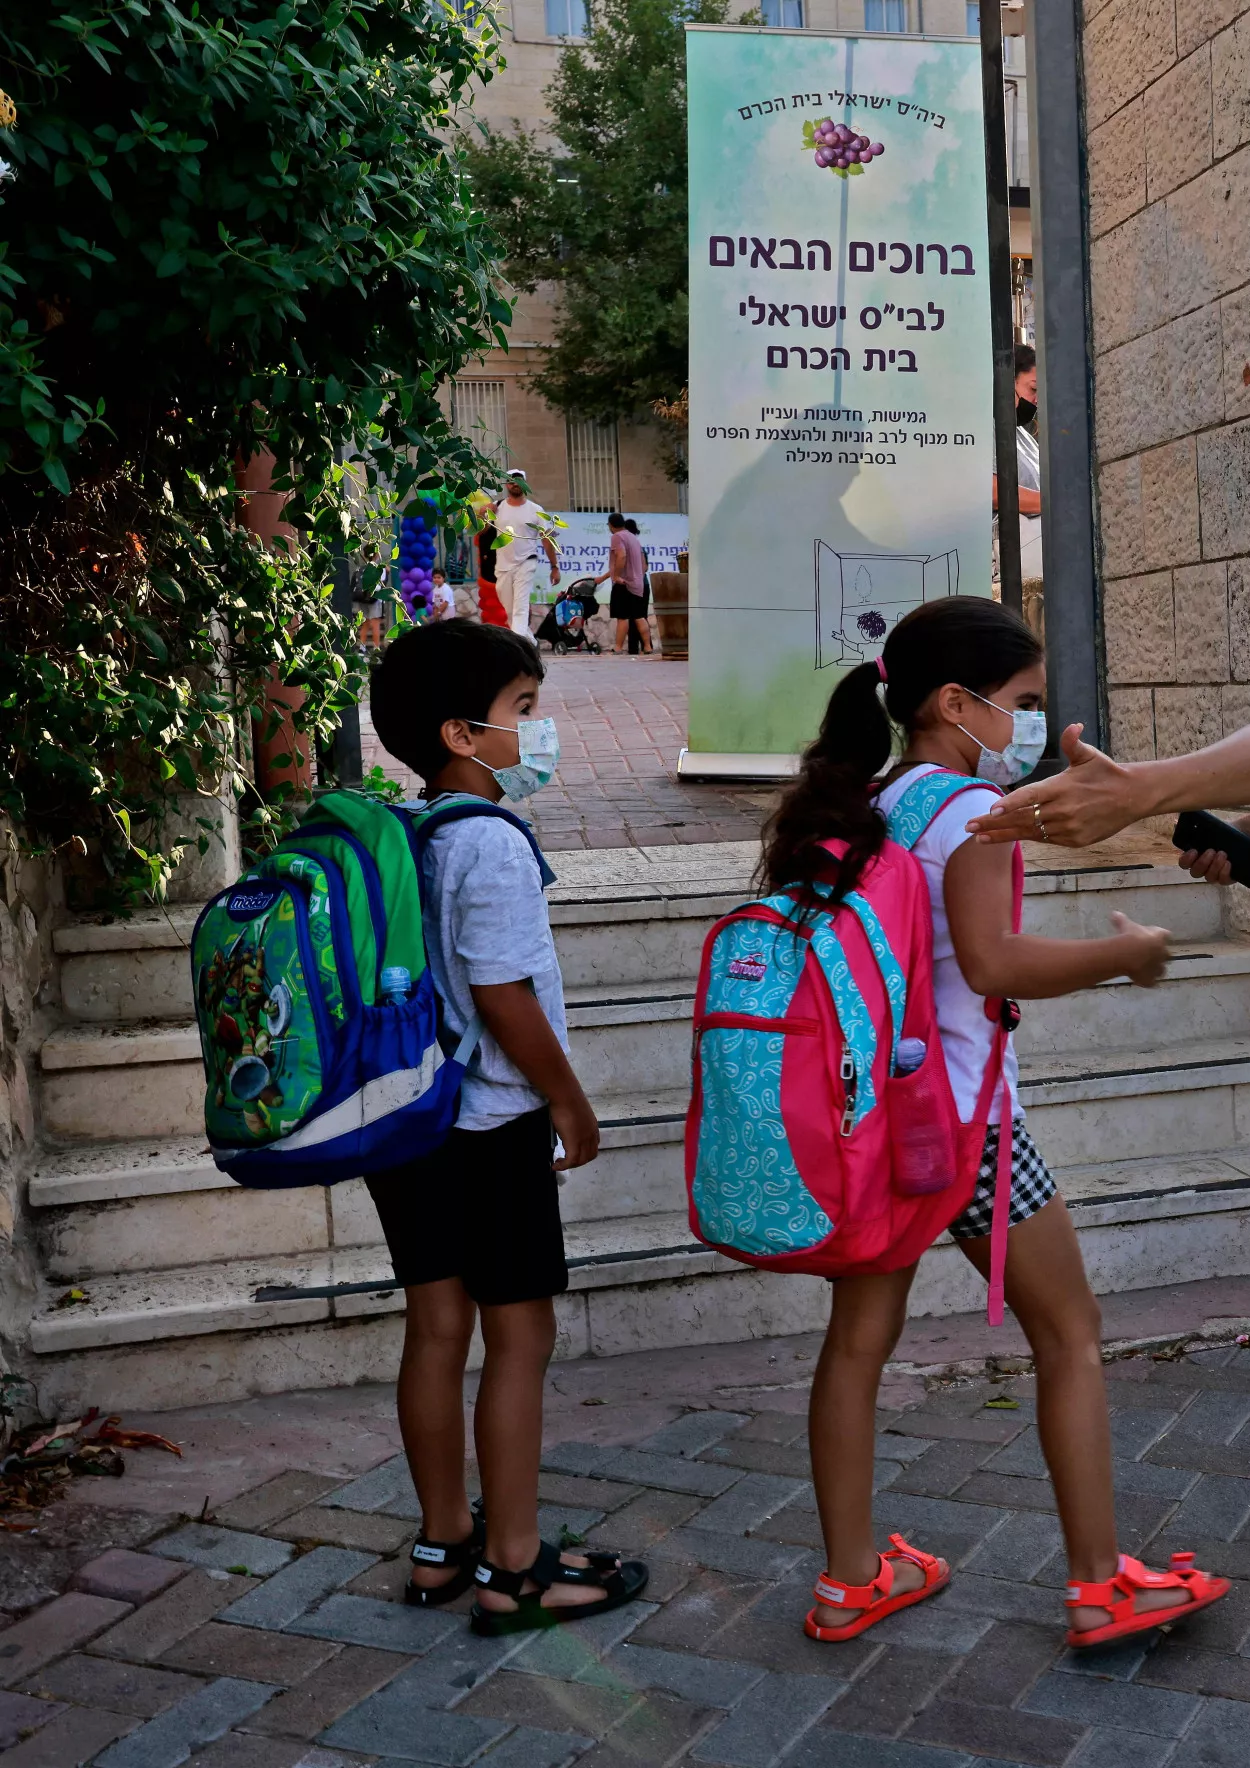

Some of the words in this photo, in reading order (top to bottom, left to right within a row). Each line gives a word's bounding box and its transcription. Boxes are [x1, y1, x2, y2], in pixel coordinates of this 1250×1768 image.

[791, 93, 823, 109] בית
[827, 89, 892, 110] ישראלי
[737, 97, 786, 121] הכרם
[709, 235, 832, 272] הבאים
[848, 241, 976, 276] ברוכים
[739, 295, 847, 329] ישראלי
[766, 345, 851, 371] הכרם
[862, 348, 919, 373] בית
[761, 407, 798, 422] ועניין
[803, 408, 863, 422] חדשנות
[867, 410, 927, 424] גמישות,
[706, 426, 750, 440] הפרט
[755, 426, 826, 442] ולהעצמת
[831, 430, 873, 443] גוניות
[878, 428, 907, 444] לרב
[913, 432, 948, 448] מנוף
[953, 433, 975, 446] הם
[786, 447, 833, 463] מכילה
[838, 451, 897, 465] בסביבה
